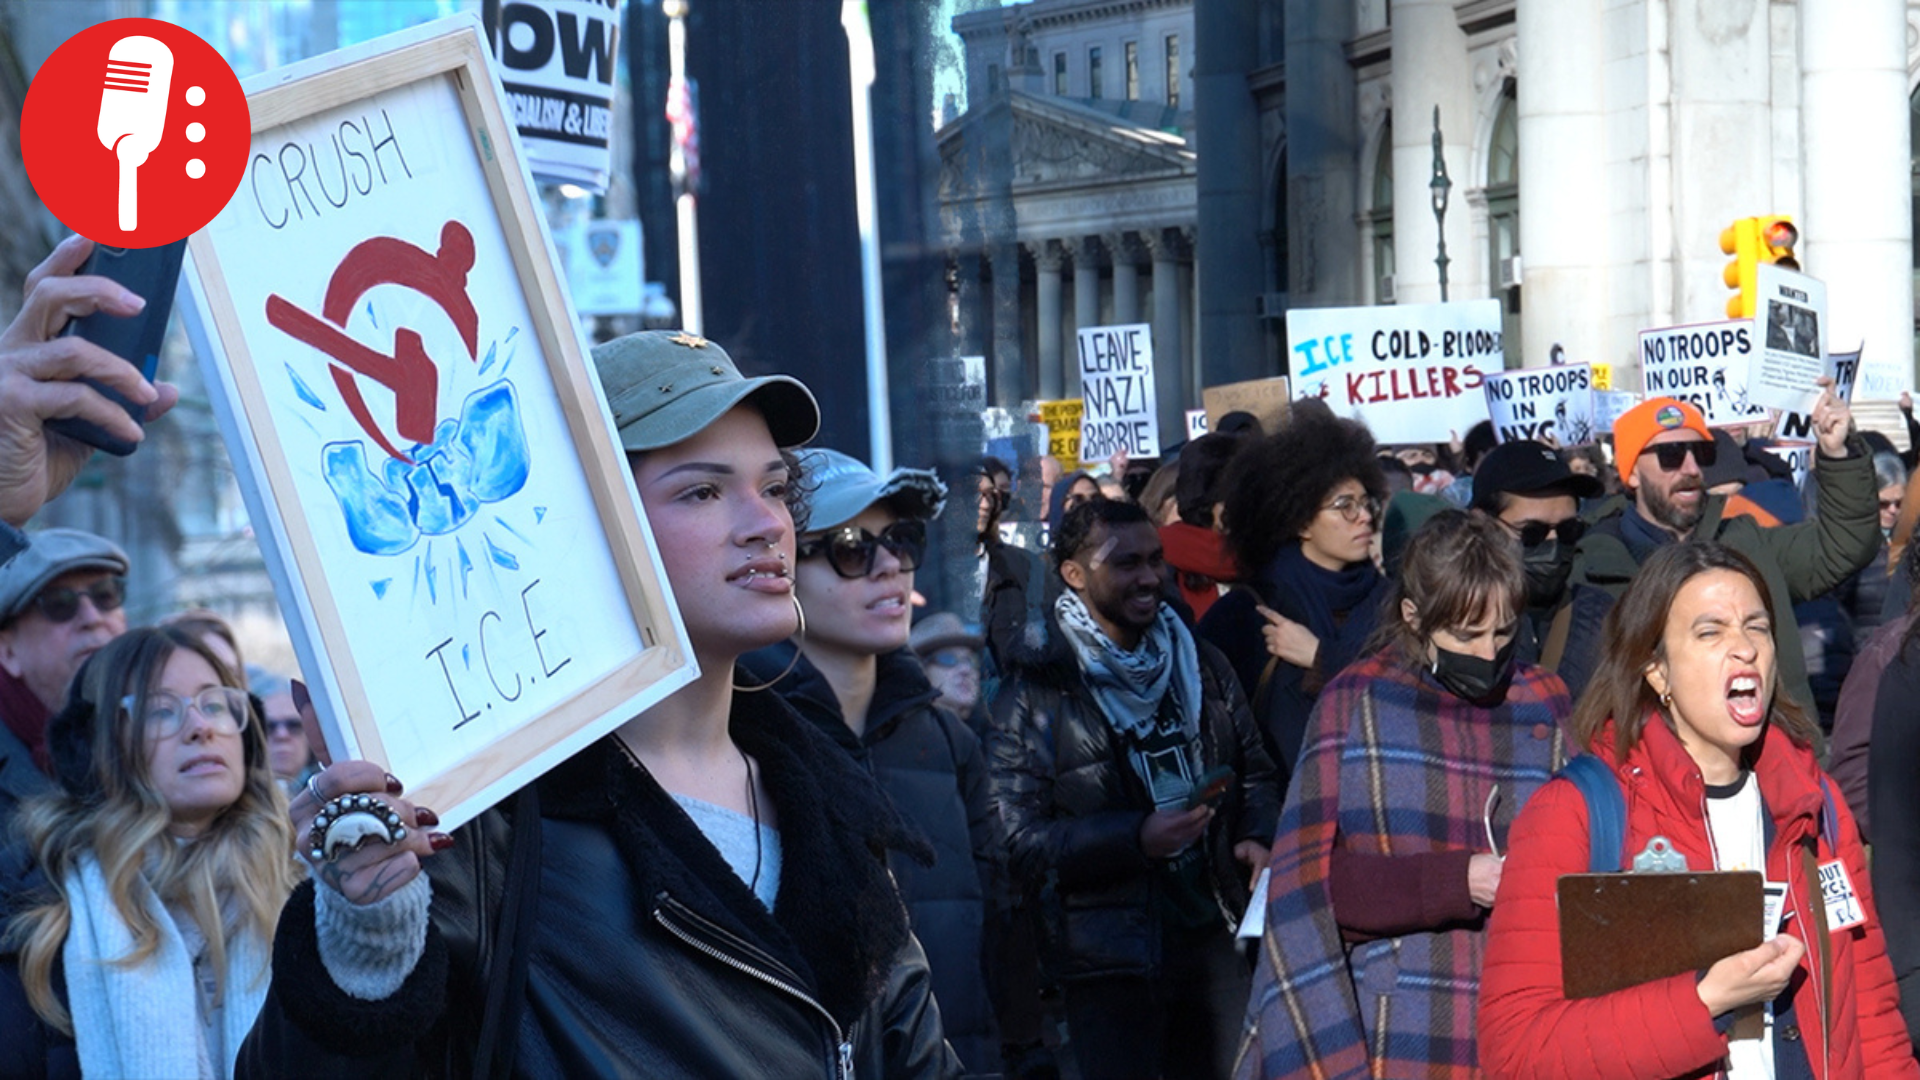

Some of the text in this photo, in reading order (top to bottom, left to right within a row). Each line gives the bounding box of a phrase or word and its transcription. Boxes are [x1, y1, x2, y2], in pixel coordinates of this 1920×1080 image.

[564, 102, 582, 134] &
[252, 109, 412, 229] CRUSH
[1079, 331, 1150, 375] LEAVE,
[1294, 333, 1353, 377] ICE
[1644, 328, 1752, 364] NO TROOPS
[1083, 375, 1147, 420] NAZI
[1346, 364, 1486, 405] KILLERS
[1487, 379, 1514, 402] NO
[1518, 369, 1589, 398] TROOPS
[1646, 366, 1709, 391] IN OUR
[1512, 401, 1537, 420] IN
[1083, 421, 1152, 460] BARBIE
